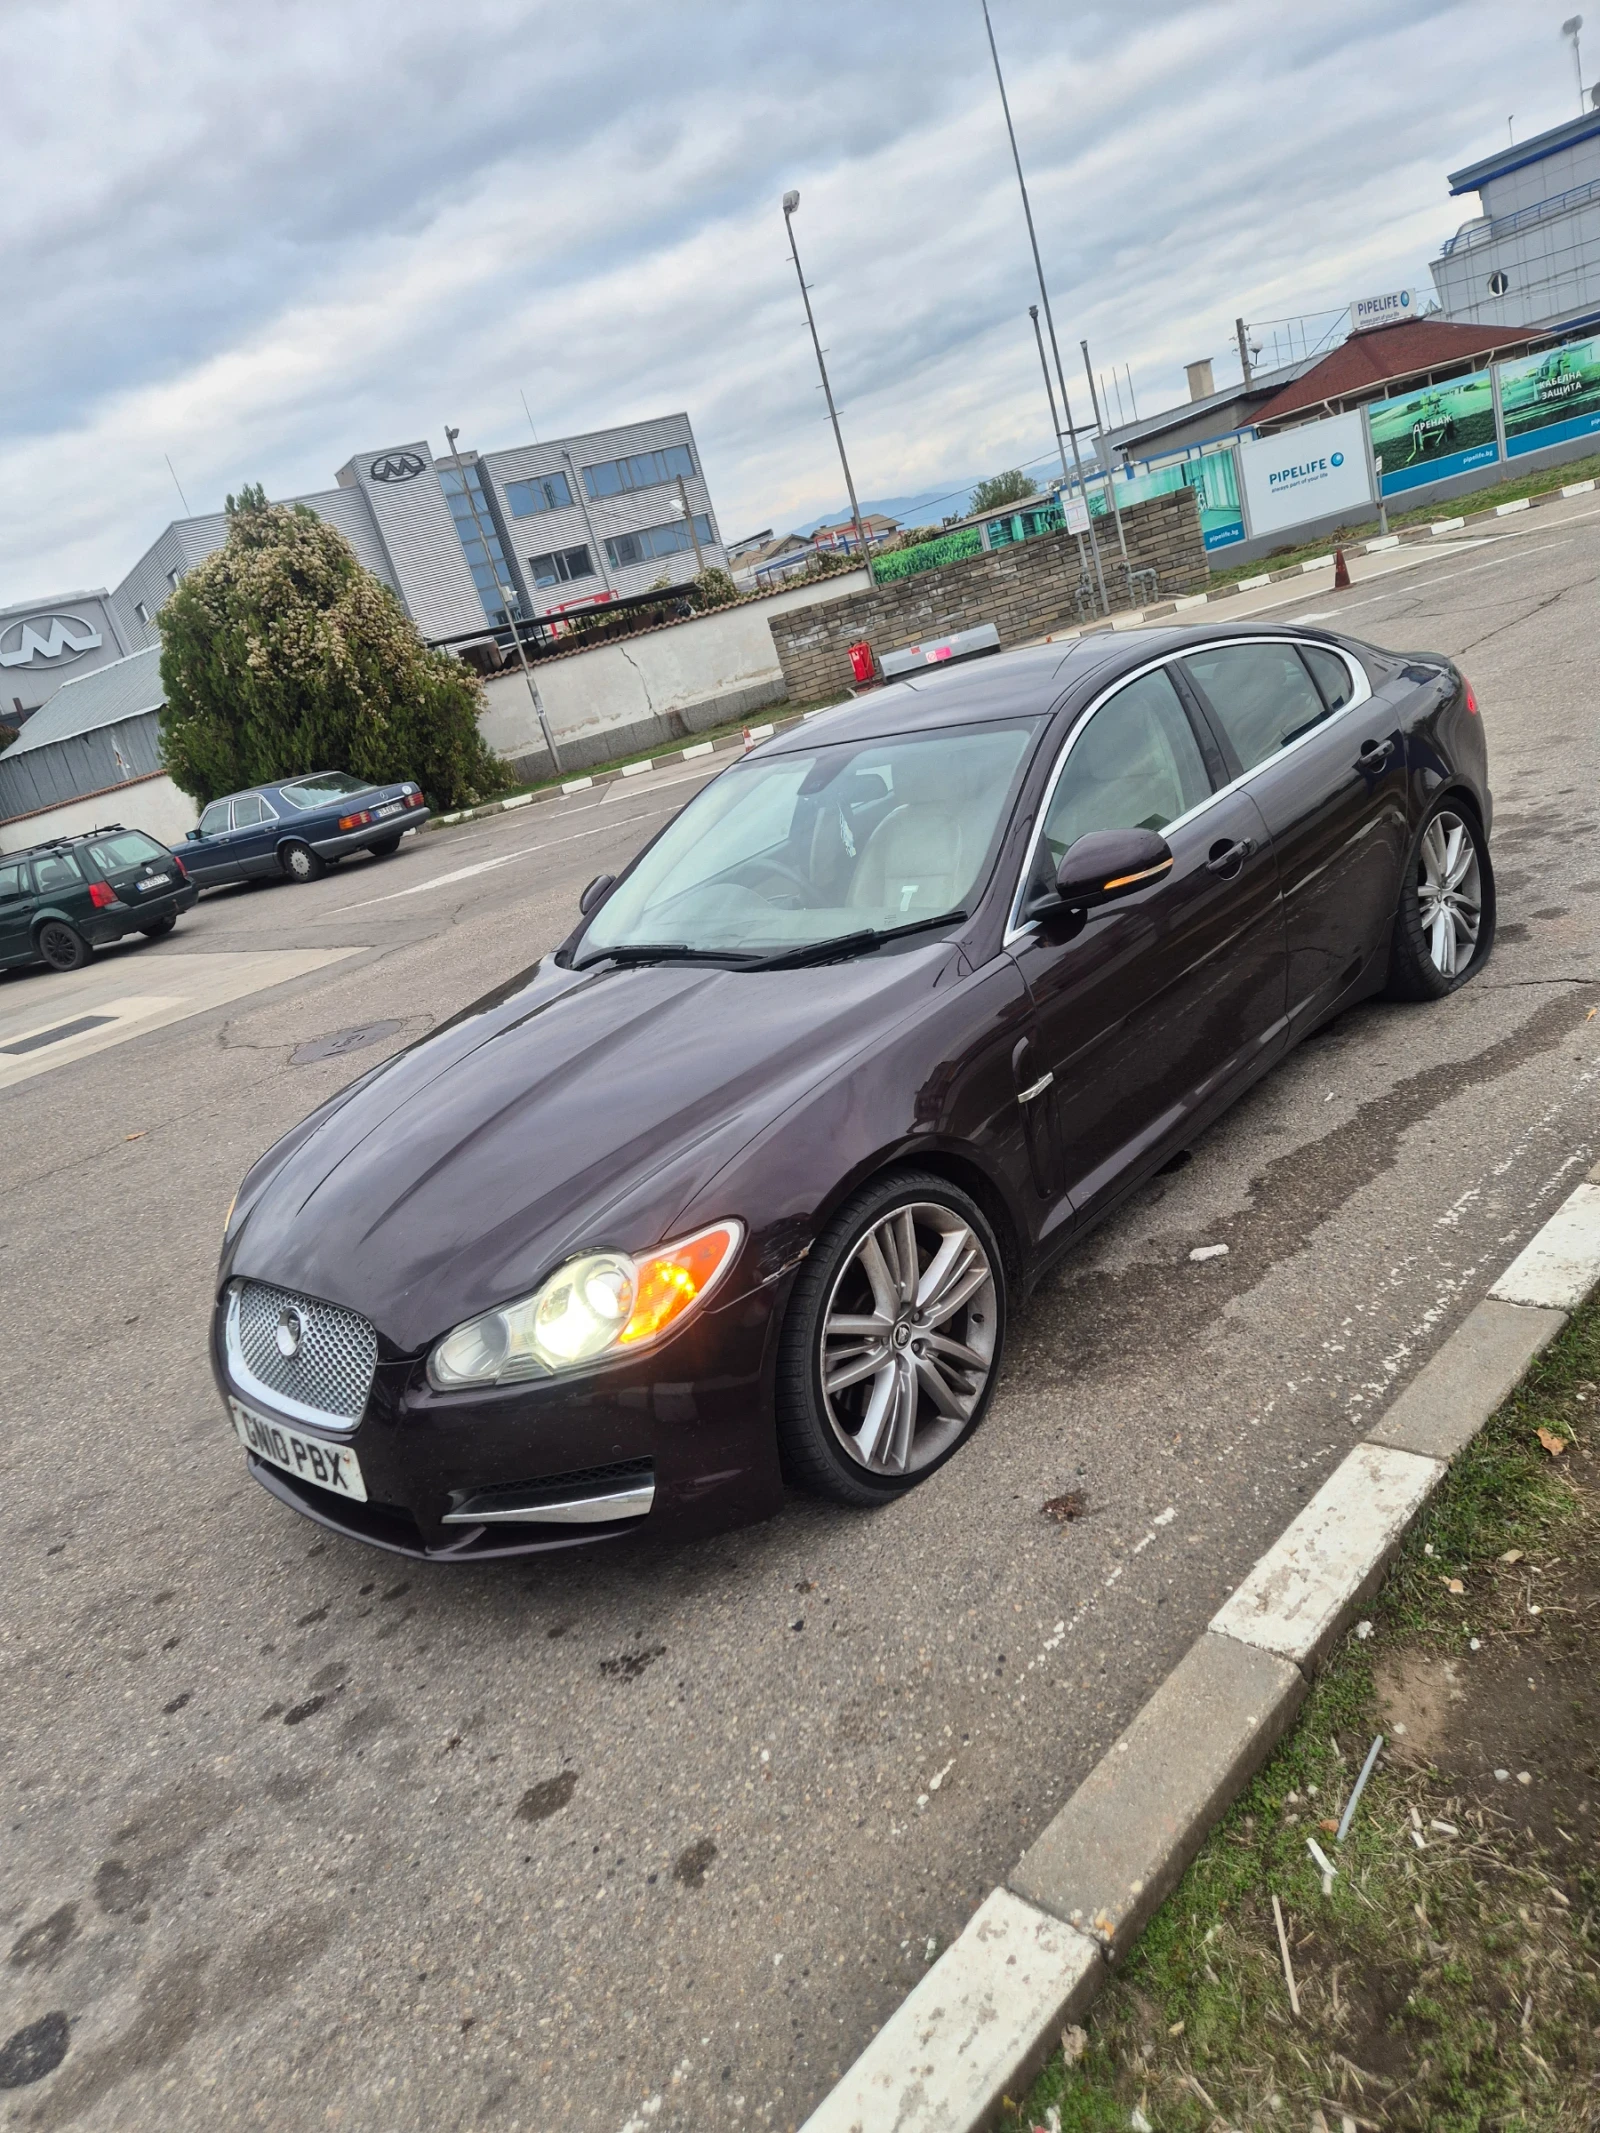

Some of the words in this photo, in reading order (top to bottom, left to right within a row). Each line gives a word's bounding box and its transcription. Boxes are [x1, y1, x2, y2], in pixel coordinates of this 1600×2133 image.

[1357, 295, 1399, 316] PIPELIFE
[1539, 370, 1582, 389] КАБЕЛНА
[1541, 381, 1582, 400] ЗАЩИТА
[1413, 415, 1453, 435] ДРЕНАЖ
[1463, 450, 1493, 464] pipelife.bg
[1269, 458, 1327, 485] PIPELIFE
[1271, 484, 1289, 493] always
[1289, 481, 1301, 489] part
[1307, 475, 1319, 483] your
[1209, 529, 1239, 543] pipelife.bg
[241, 1411, 290, 1466] GN10
[290, 1437, 348, 1490] PBX
